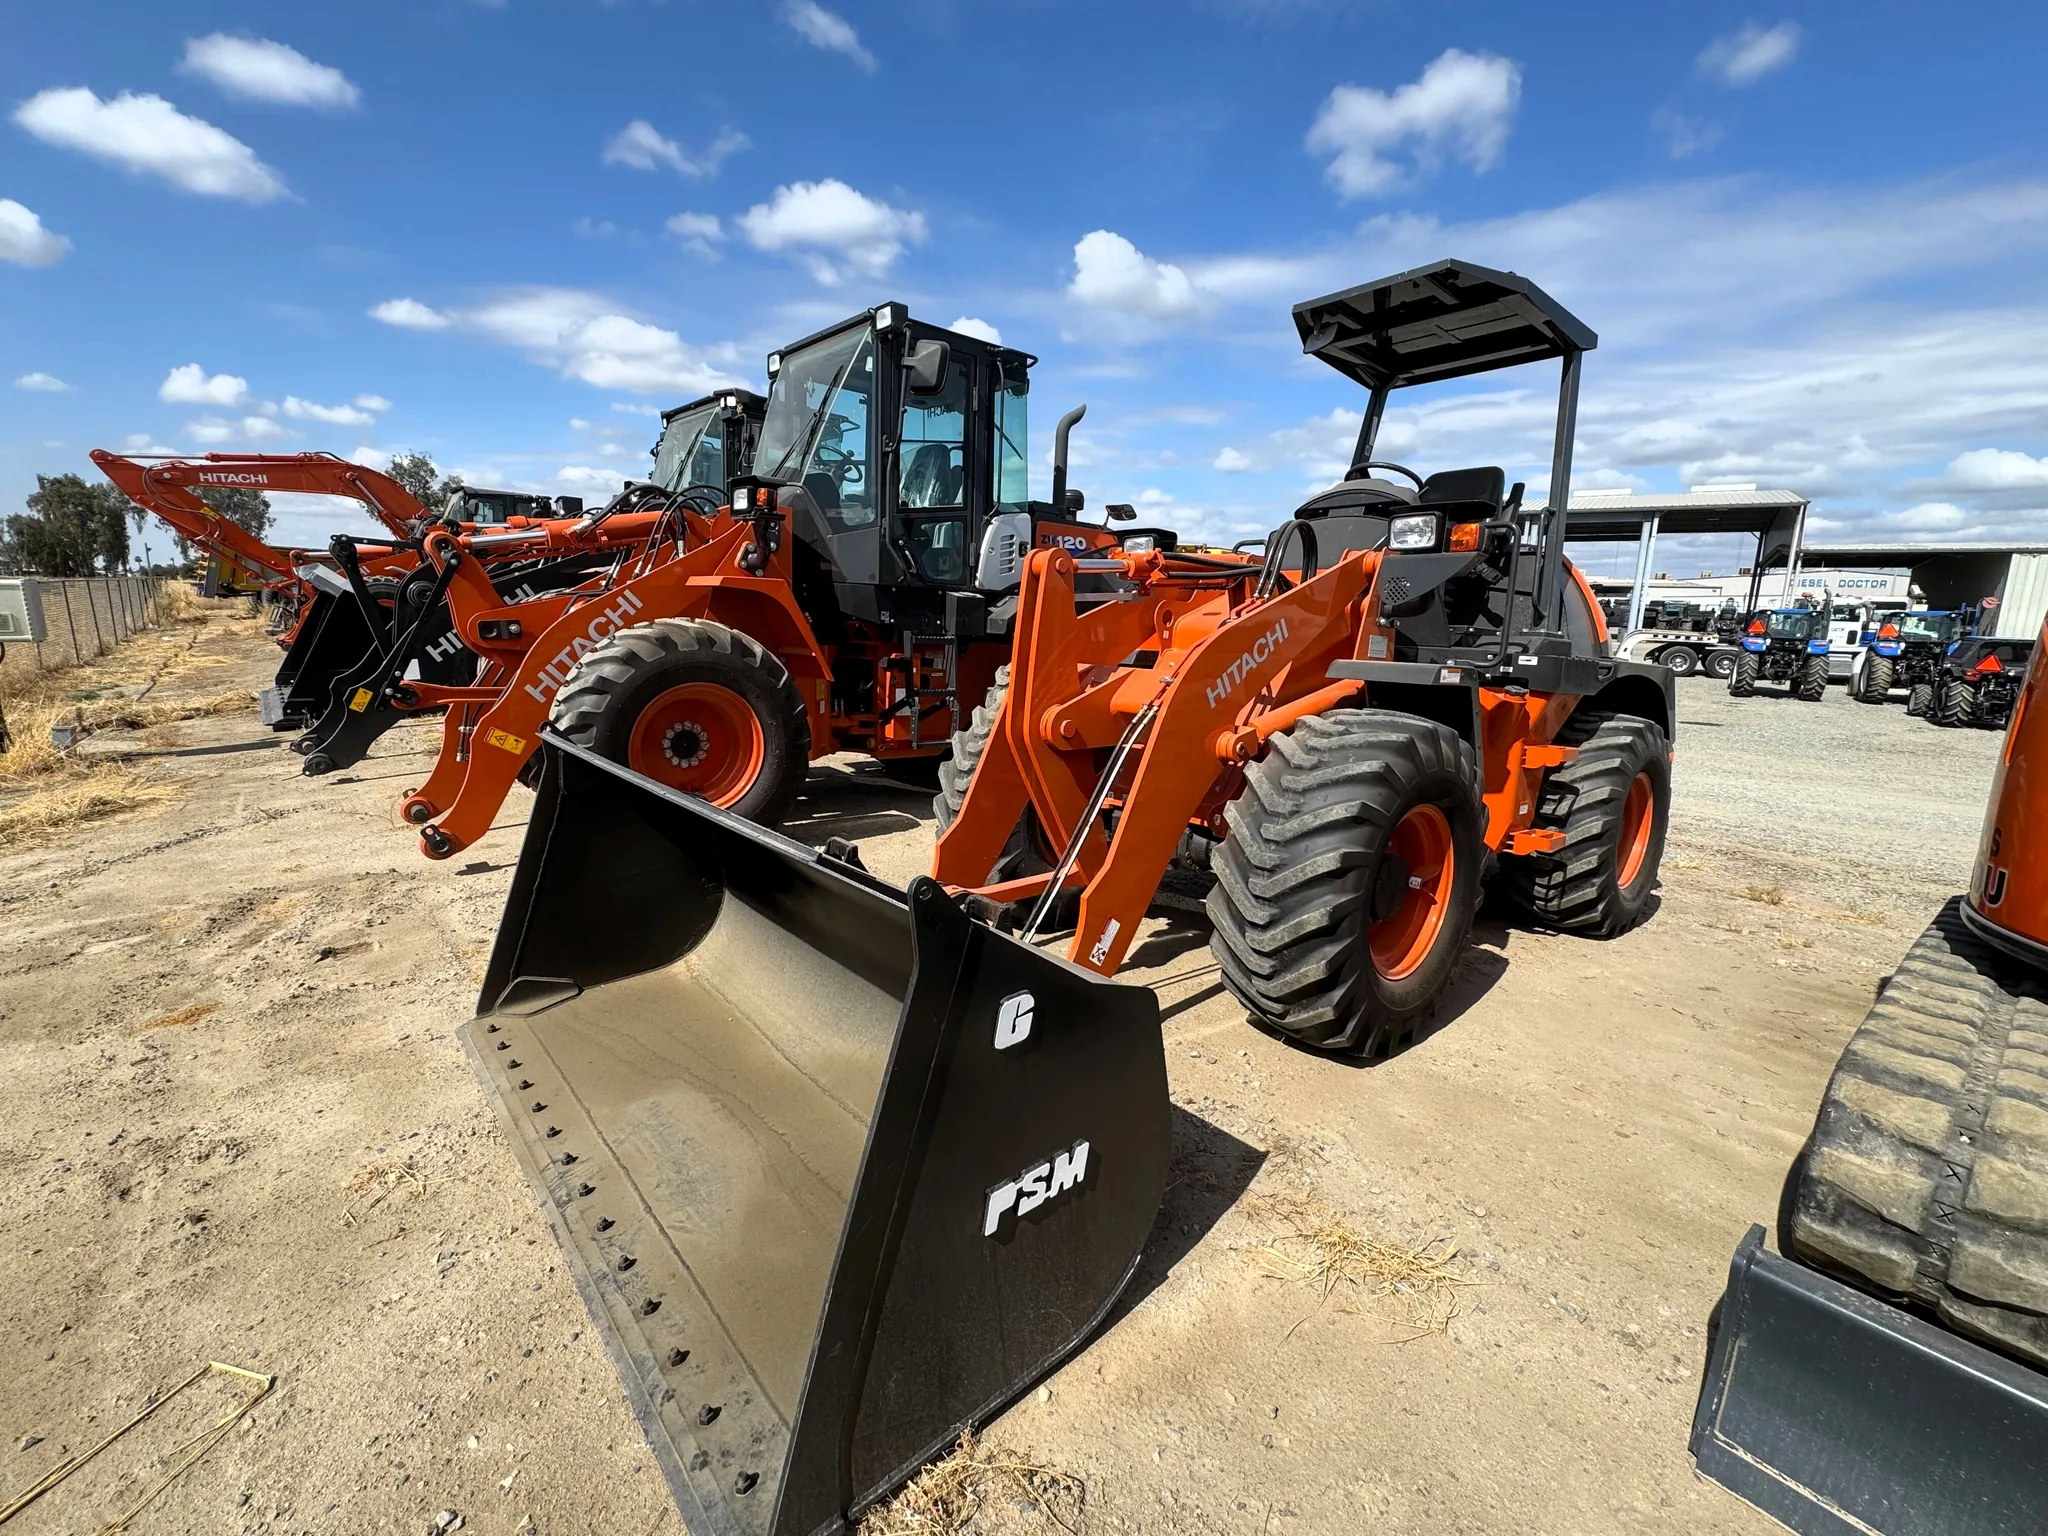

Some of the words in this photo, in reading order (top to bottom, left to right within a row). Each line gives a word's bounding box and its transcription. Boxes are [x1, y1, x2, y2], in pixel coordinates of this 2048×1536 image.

[199, 472, 268, 484] HITACHI
[1838, 580, 1888, 588] DOCTOR
[524, 589, 643, 703] HITACHI
[1206, 618, 1289, 709] HITACHI
